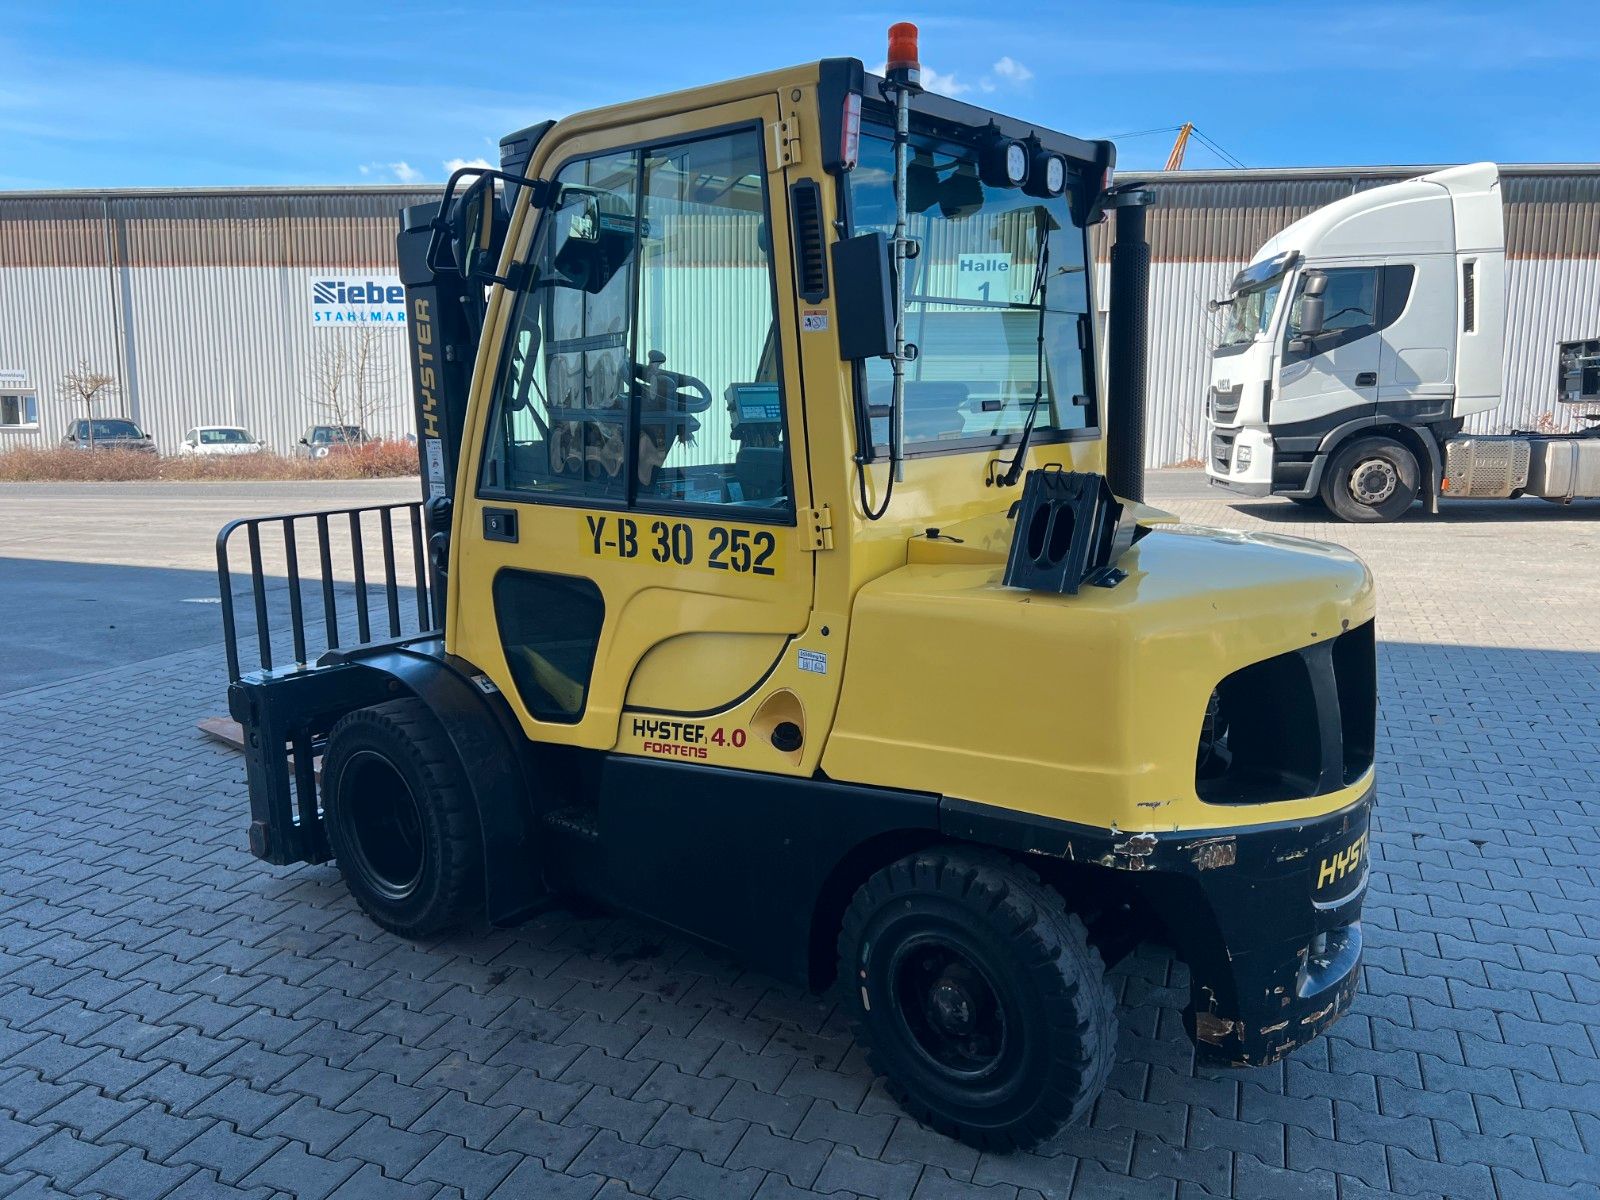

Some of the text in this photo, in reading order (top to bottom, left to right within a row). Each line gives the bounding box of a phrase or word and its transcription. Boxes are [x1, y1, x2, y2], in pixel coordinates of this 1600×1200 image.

[960, 260, 1008, 271] Halle
[978, 281, 990, 302] 1
[414, 298, 439, 438] HYSTER
[586, 516, 775, 576] Y-B 30 252
[711, 728, 746, 747] 4.0
[643, 741, 707, 758] FORTENS
